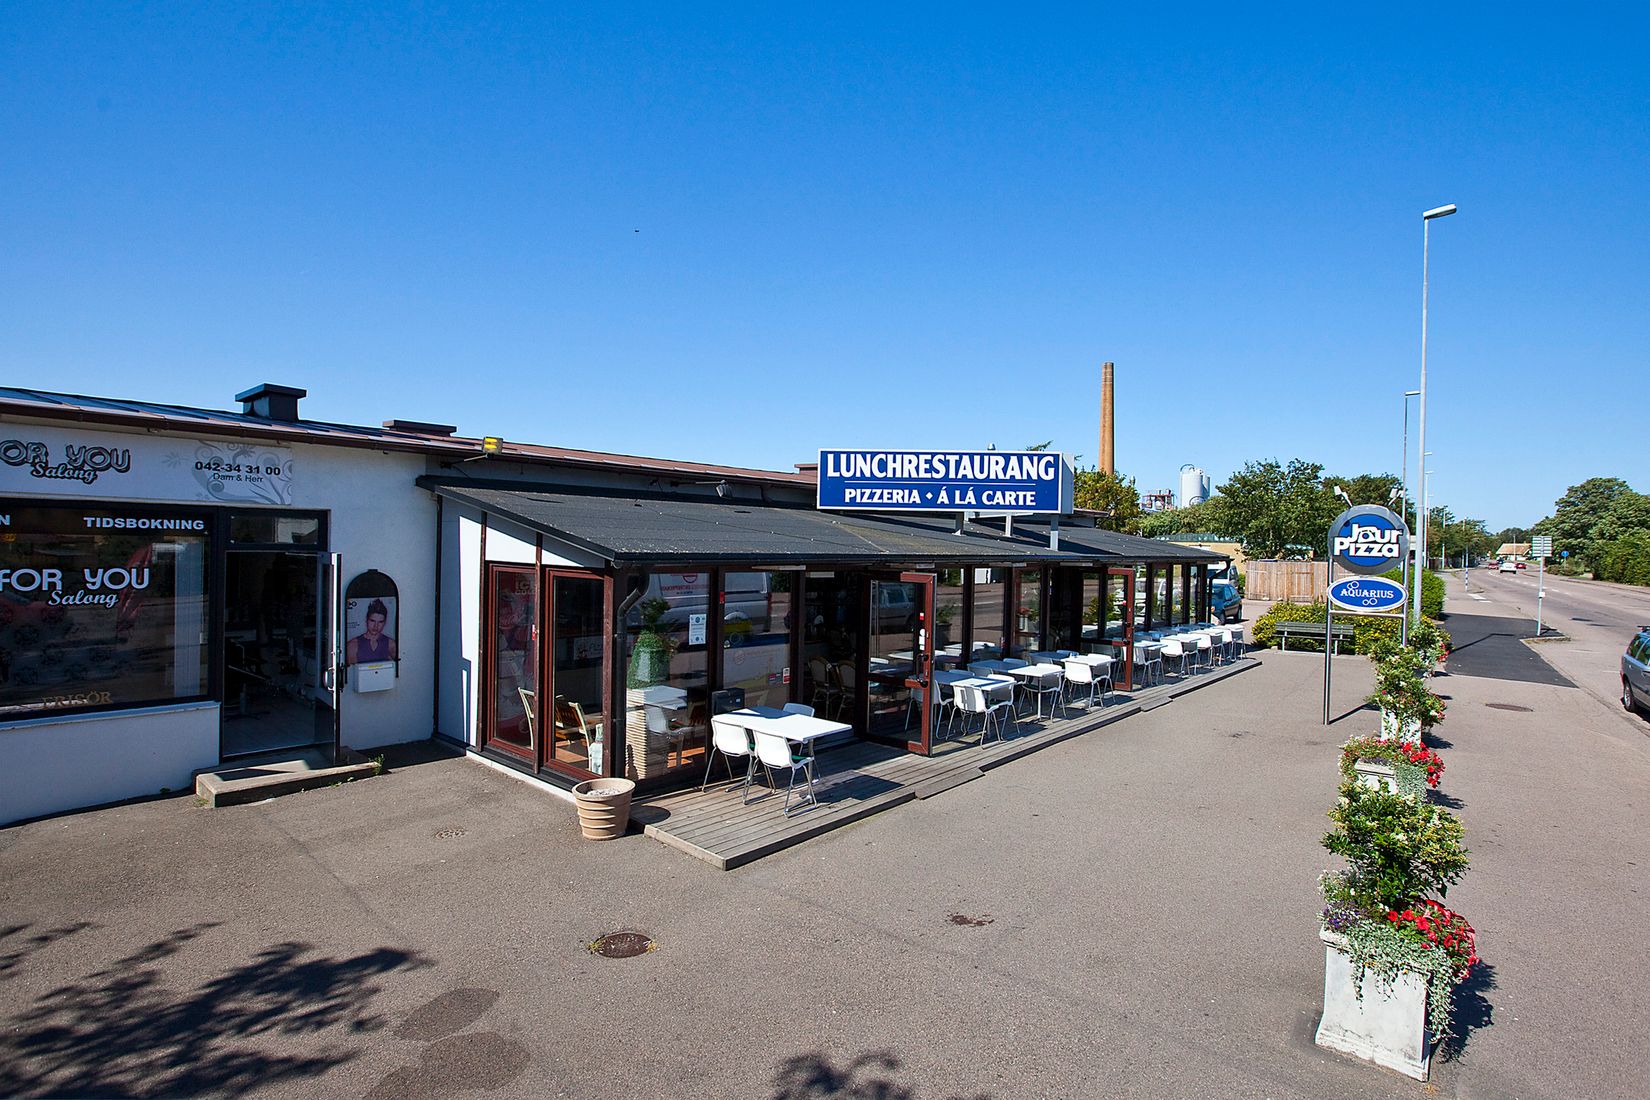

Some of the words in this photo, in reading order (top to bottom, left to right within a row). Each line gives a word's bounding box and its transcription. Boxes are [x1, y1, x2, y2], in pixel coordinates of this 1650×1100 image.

[65, 444, 131, 473] YOU
[195, 461, 241, 473] 042-34
[245, 465, 260, 474] 31
[265, 466, 281, 476] 00
[827, 453, 1055, 481] LUNCHRESTAURANG
[30, 461, 98, 484] Salong
[213, 472, 234, 481] Dam
[236, 474, 243, 482] &
[245, 474, 264, 483] Herr
[844, 488, 921, 504] PIZZERIA
[937, 486, 950, 505] Á
[955, 486, 977, 505] LÁ
[981, 490, 1036, 506] CARTE
[83, 516, 205, 530] TIDSBOKNING
[1348, 523, 1403, 543] Jour
[1333, 537, 1400, 558] Pizza
[84, 567, 150, 590] YOU
[48, 589, 119, 609] Salong
[1340, 588, 1394, 599] AQUARIUS
[41, 690, 113, 709] FRISÖR
